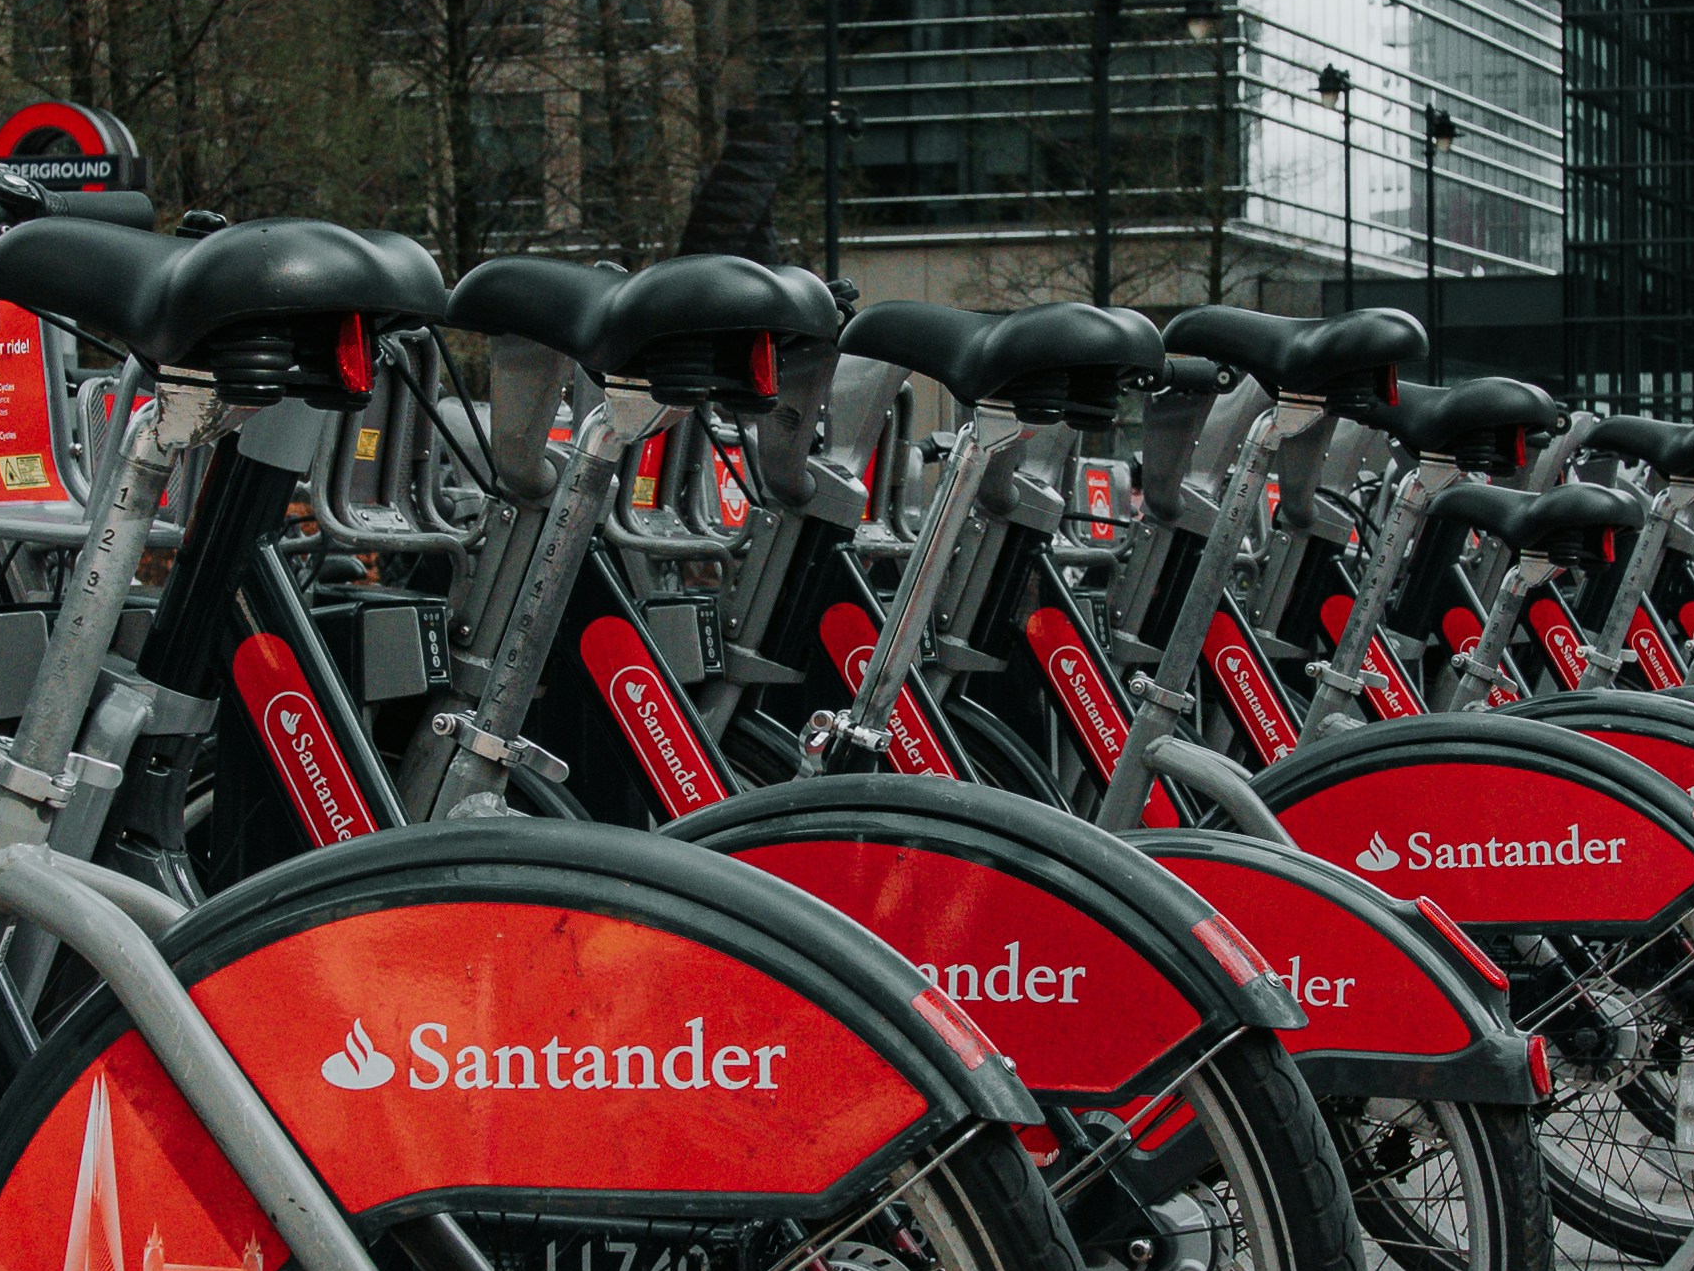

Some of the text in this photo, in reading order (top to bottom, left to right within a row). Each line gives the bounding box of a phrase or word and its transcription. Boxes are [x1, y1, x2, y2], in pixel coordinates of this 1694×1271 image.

[7, 161, 111, 179] DERGROUND
[6, 338, 30, 355] ride!
[119, 486, 129, 503] 1
[559, 508, 569, 522] 2
[101, 529, 115, 546] 2
[546, 544, 555, 557] 3
[87, 571, 99, 587] 3
[533, 580, 544, 593] 4
[72, 615, 84, 628] 4
[508, 648, 517, 663] 6
[1561, 644, 1583, 681] Santa
[1645, 647, 1676, 689] Santand
[495, 684, 505, 698] 7
[1069, 673, 1120, 753] Santander
[1234, 670, 1280, 743] Santander
[889, 710, 925, 766] ander
[637, 701, 702, 803] Santander
[291, 733, 354, 842] Santande
[1408, 823, 1626, 870] Santander
[916, 940, 1086, 1004] ander
[409, 1016, 786, 1091] Santander
